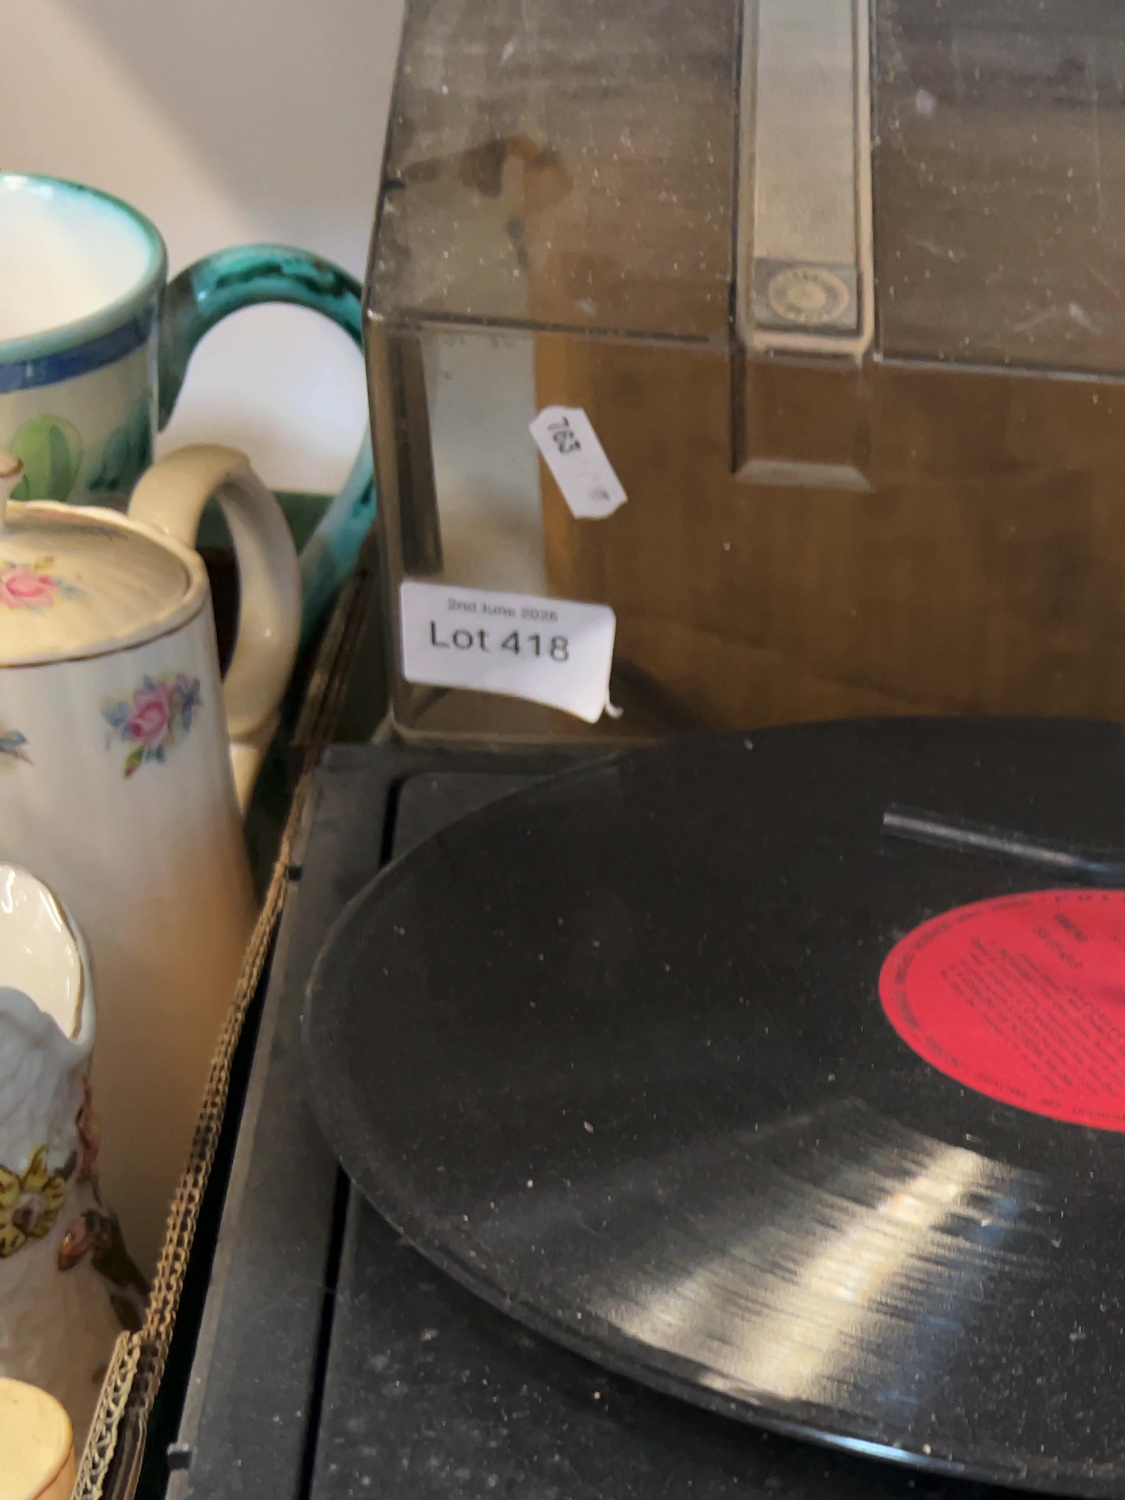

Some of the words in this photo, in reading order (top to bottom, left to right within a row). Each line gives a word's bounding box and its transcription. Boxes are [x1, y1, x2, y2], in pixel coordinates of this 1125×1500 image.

[447, 597, 477, 612] 2nd
[480, 602, 517, 617] June
[430, 619, 490, 653] Lot
[500, 629, 570, 663] 418
